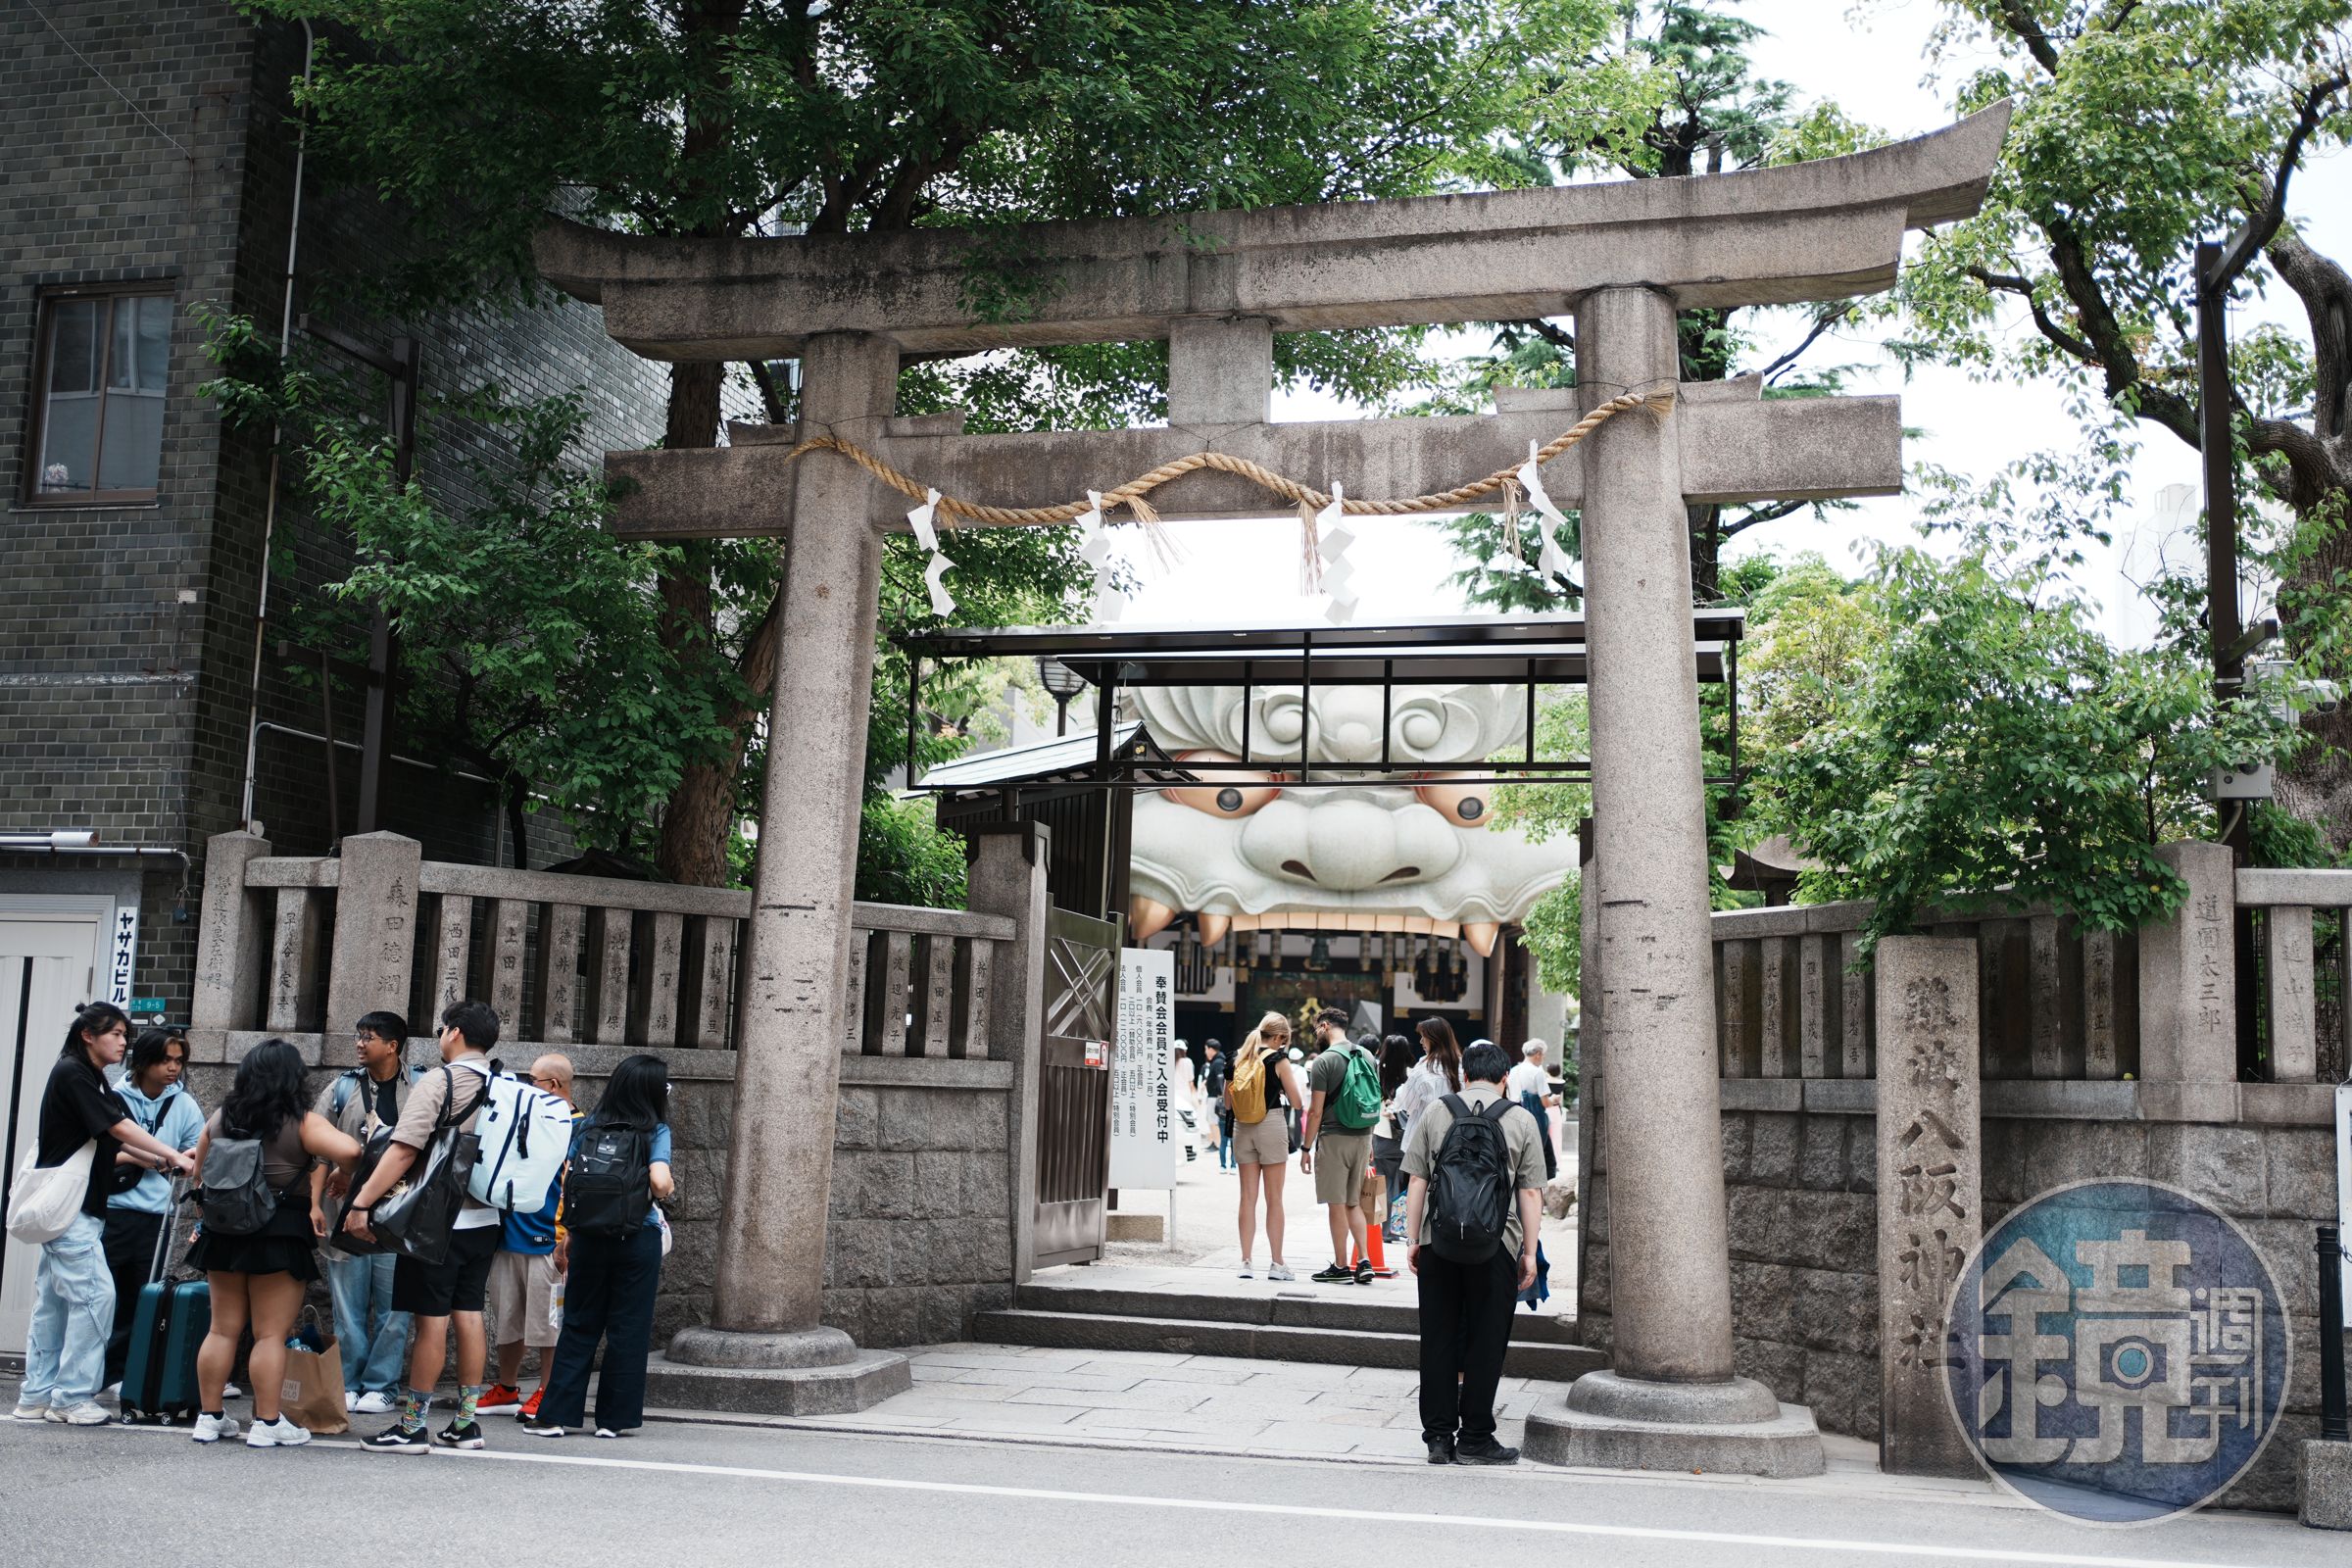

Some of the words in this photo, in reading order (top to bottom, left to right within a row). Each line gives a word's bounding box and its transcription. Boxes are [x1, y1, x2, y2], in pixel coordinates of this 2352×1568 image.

[113, 912, 134, 1004] ヤサカビル
[147, 1001, 160, 1009] 9-5
[1155, 975, 1168, 1144] 奉賛会会員ご入会受付中
